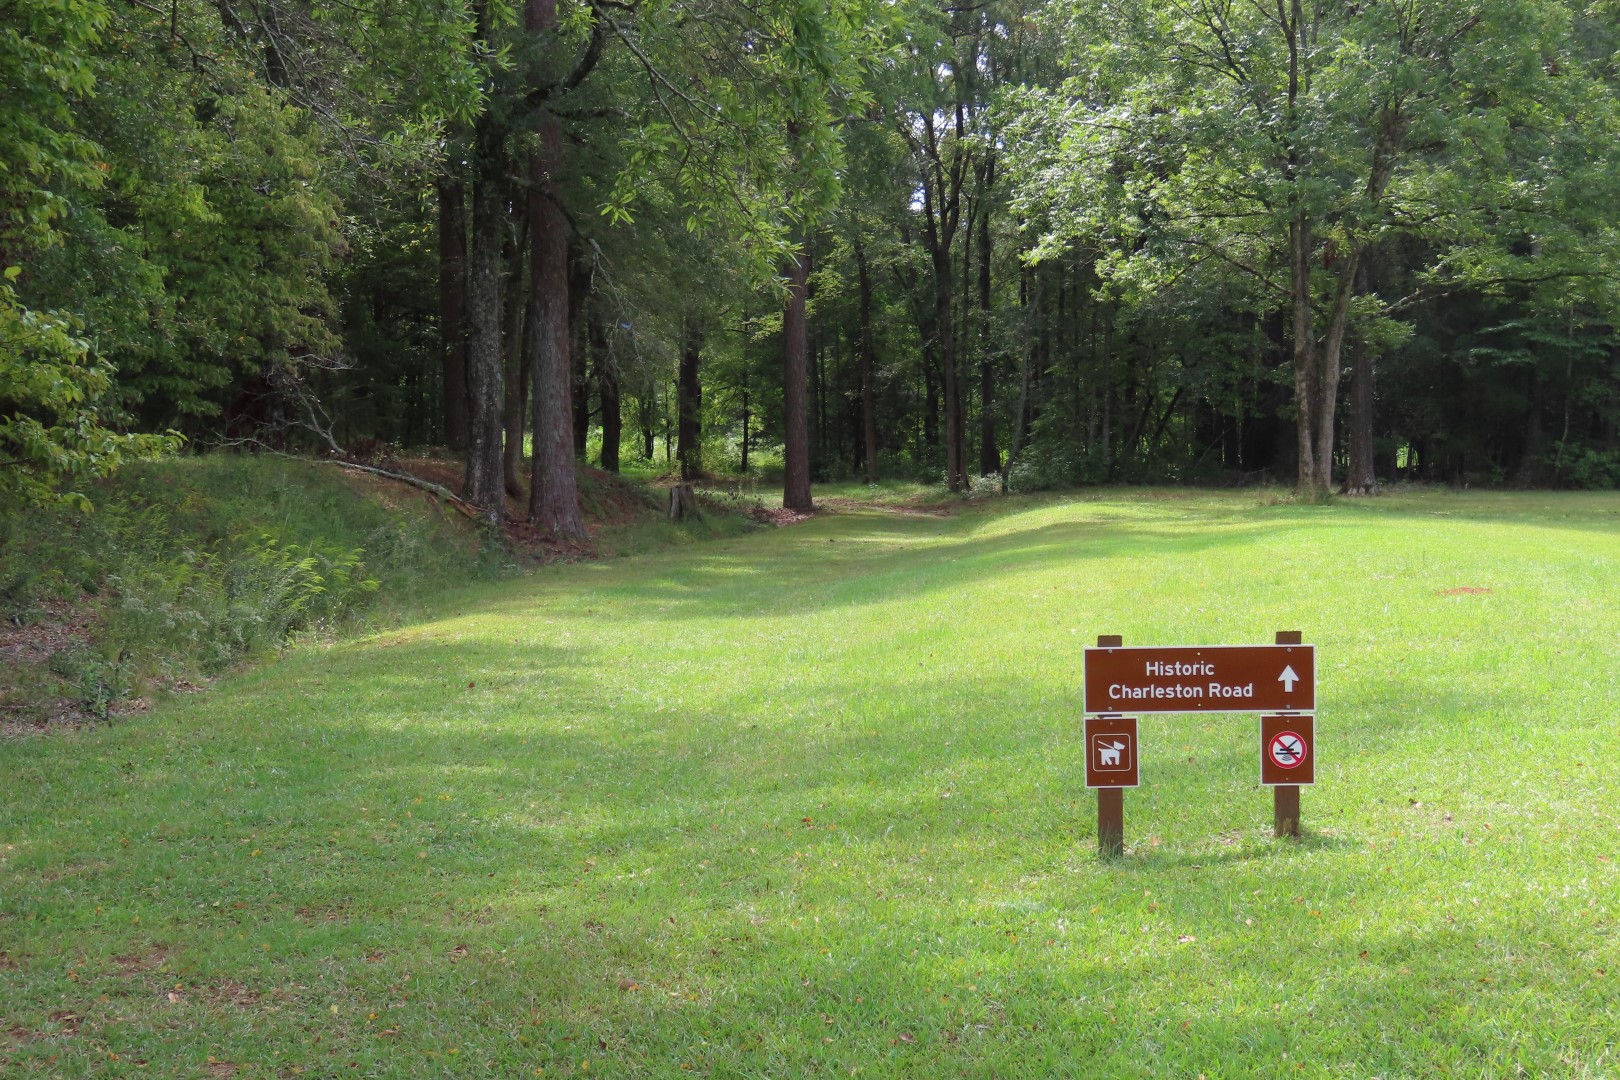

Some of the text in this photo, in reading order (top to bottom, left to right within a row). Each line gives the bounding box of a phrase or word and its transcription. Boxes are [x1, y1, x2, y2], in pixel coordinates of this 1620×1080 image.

[1146, 661, 1215, 676] Historic
[1108, 682, 1253, 699] Charleston Road
